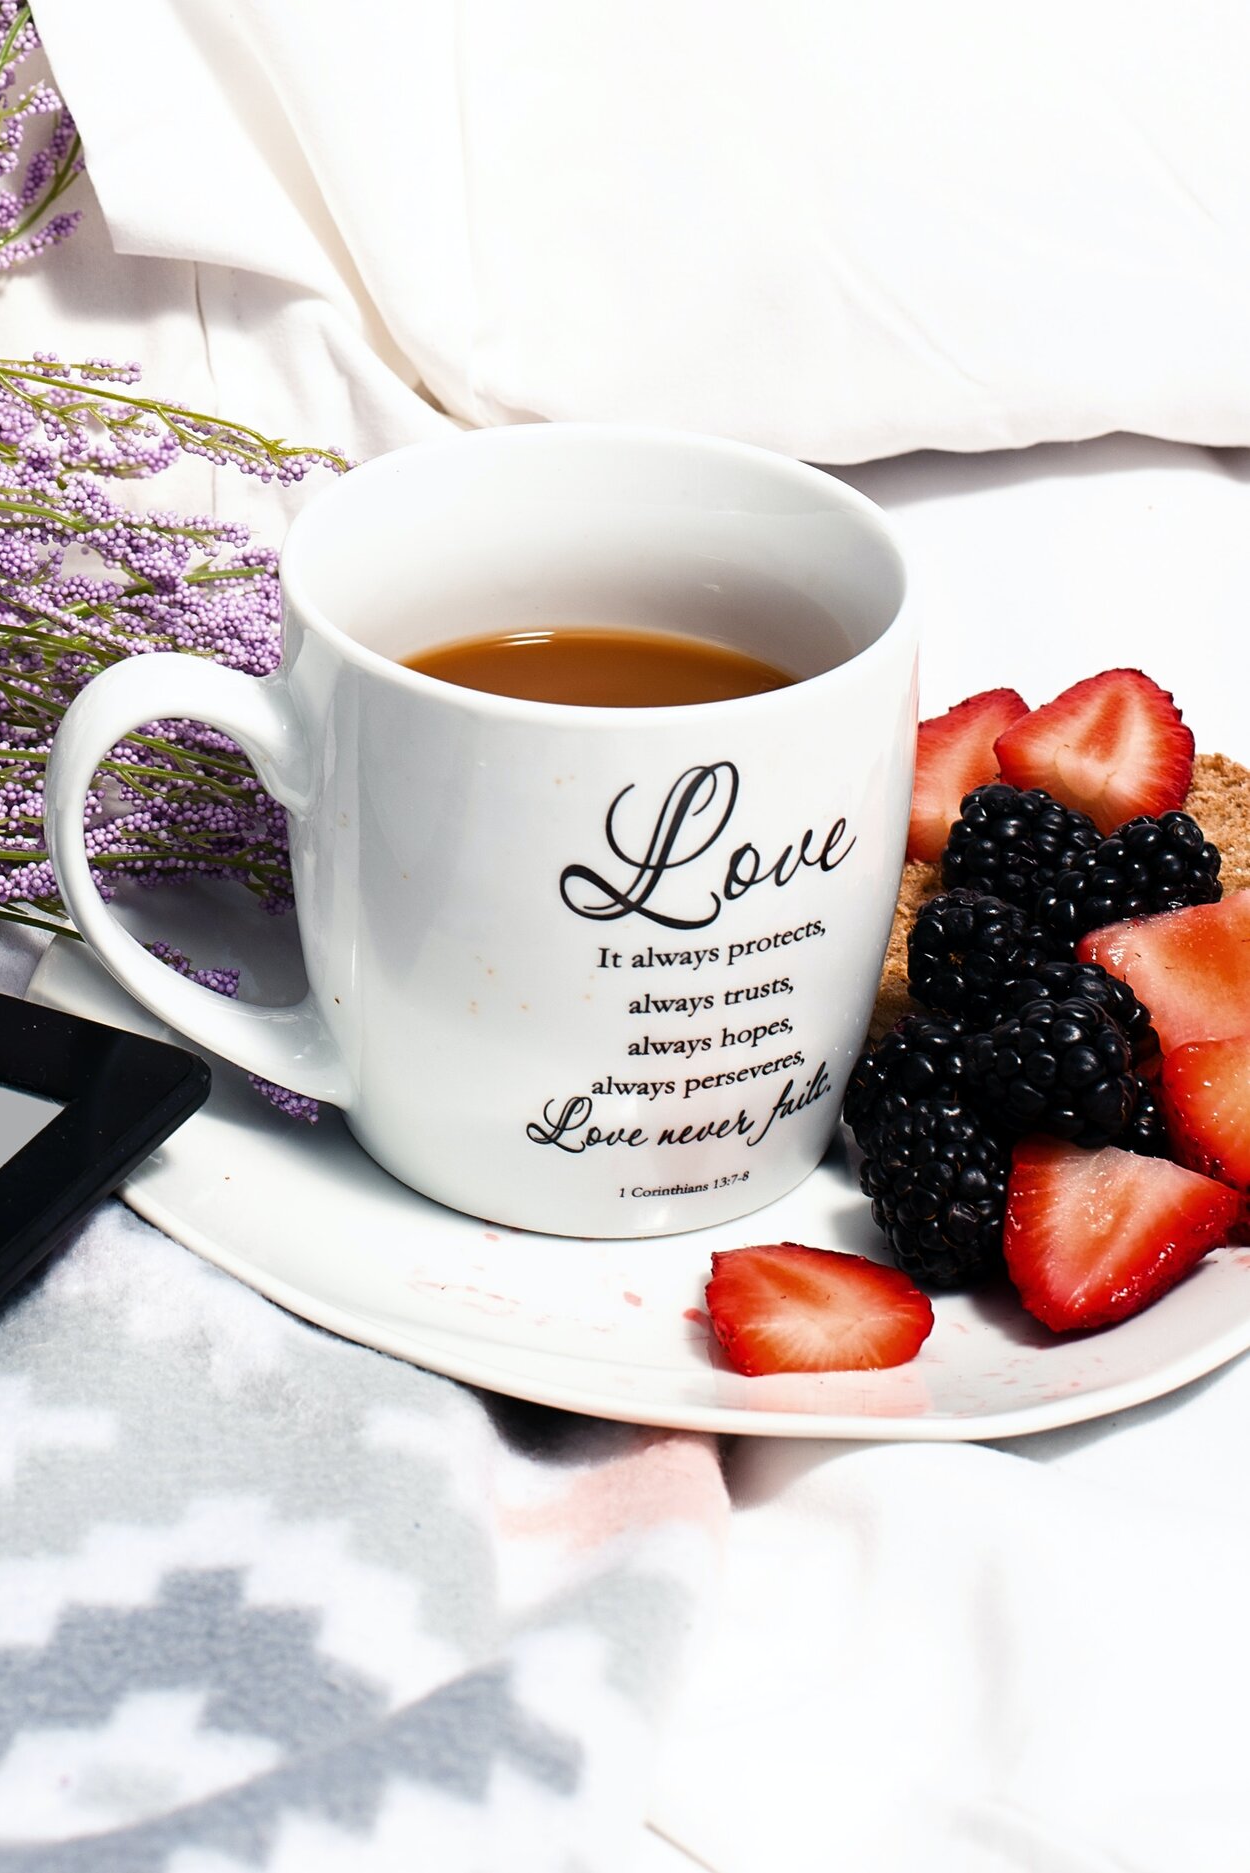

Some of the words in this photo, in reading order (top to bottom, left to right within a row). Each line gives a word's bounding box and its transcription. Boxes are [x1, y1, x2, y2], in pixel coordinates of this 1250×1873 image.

[559, 760, 857, 931] Love
[597, 947, 623, 969] It
[631, 946, 720, 971] always
[727, 919, 827, 966] protects,
[628, 993, 715, 1018] always
[724, 976, 795, 1006] trusts,
[627, 1035, 713, 1060] always
[720, 1017, 794, 1048] hopes,
[591, 1075, 676, 1102] always
[682, 1049, 806, 1100] perseveres,
[525, 1096, 649, 1154] Love
[656, 1109, 755, 1147] never
[619, 1187, 626, 1198] 1
[631, 1181, 709, 1198] Corinthians
[713, 1170, 750, 1190] 13:7-8
